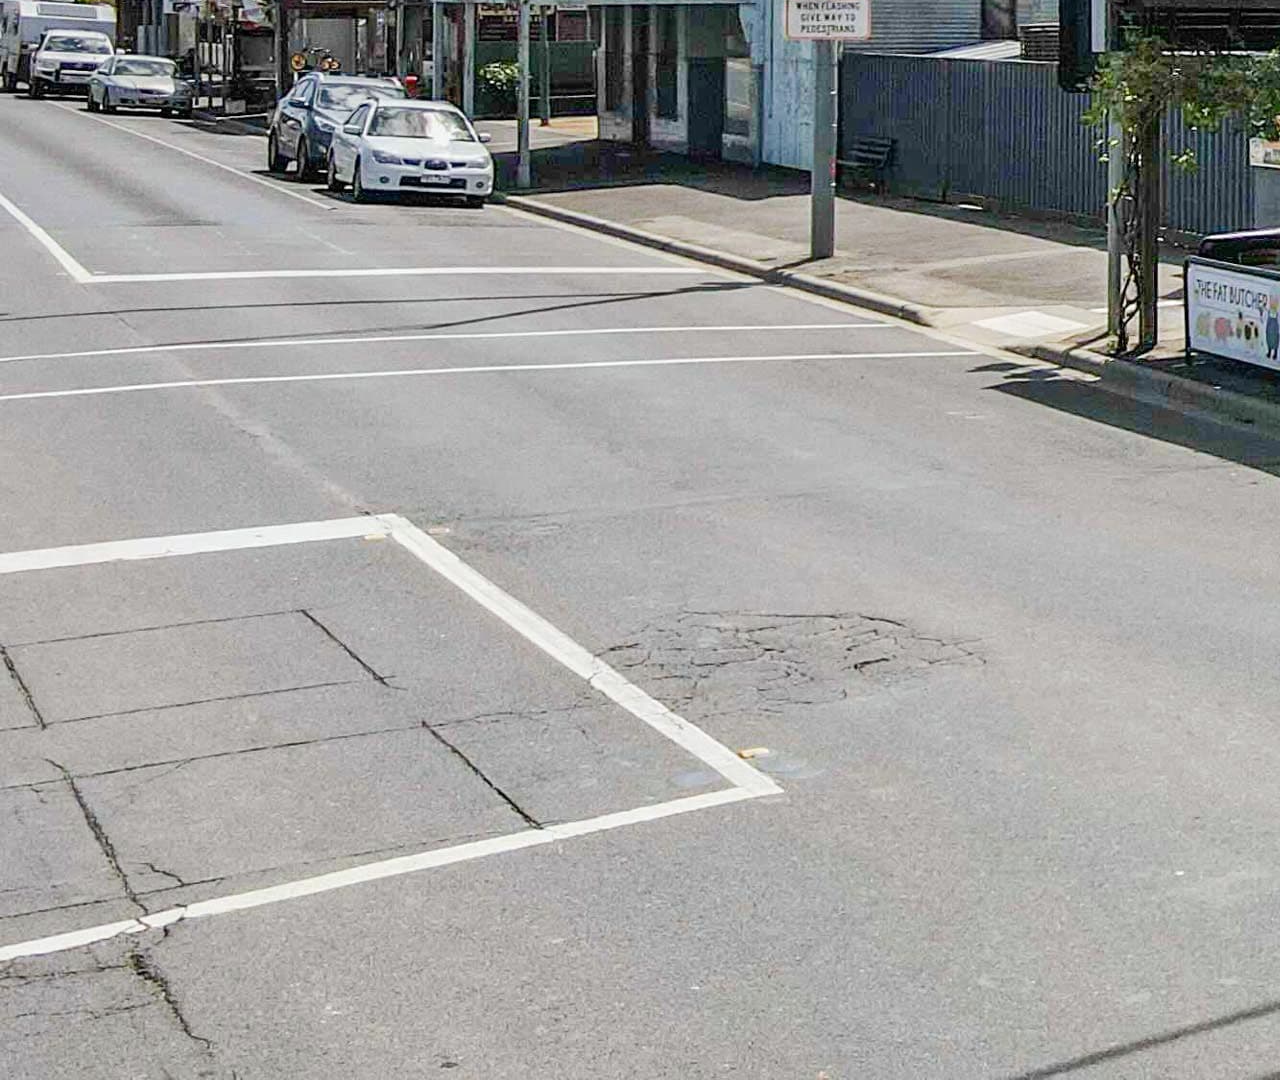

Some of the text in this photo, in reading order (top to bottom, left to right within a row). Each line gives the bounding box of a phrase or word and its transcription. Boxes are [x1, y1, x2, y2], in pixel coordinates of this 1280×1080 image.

[801, 25, 856, 33] PEDESTRIANS
[1197, 279, 1268, 310] THE FAT BUTCHER
